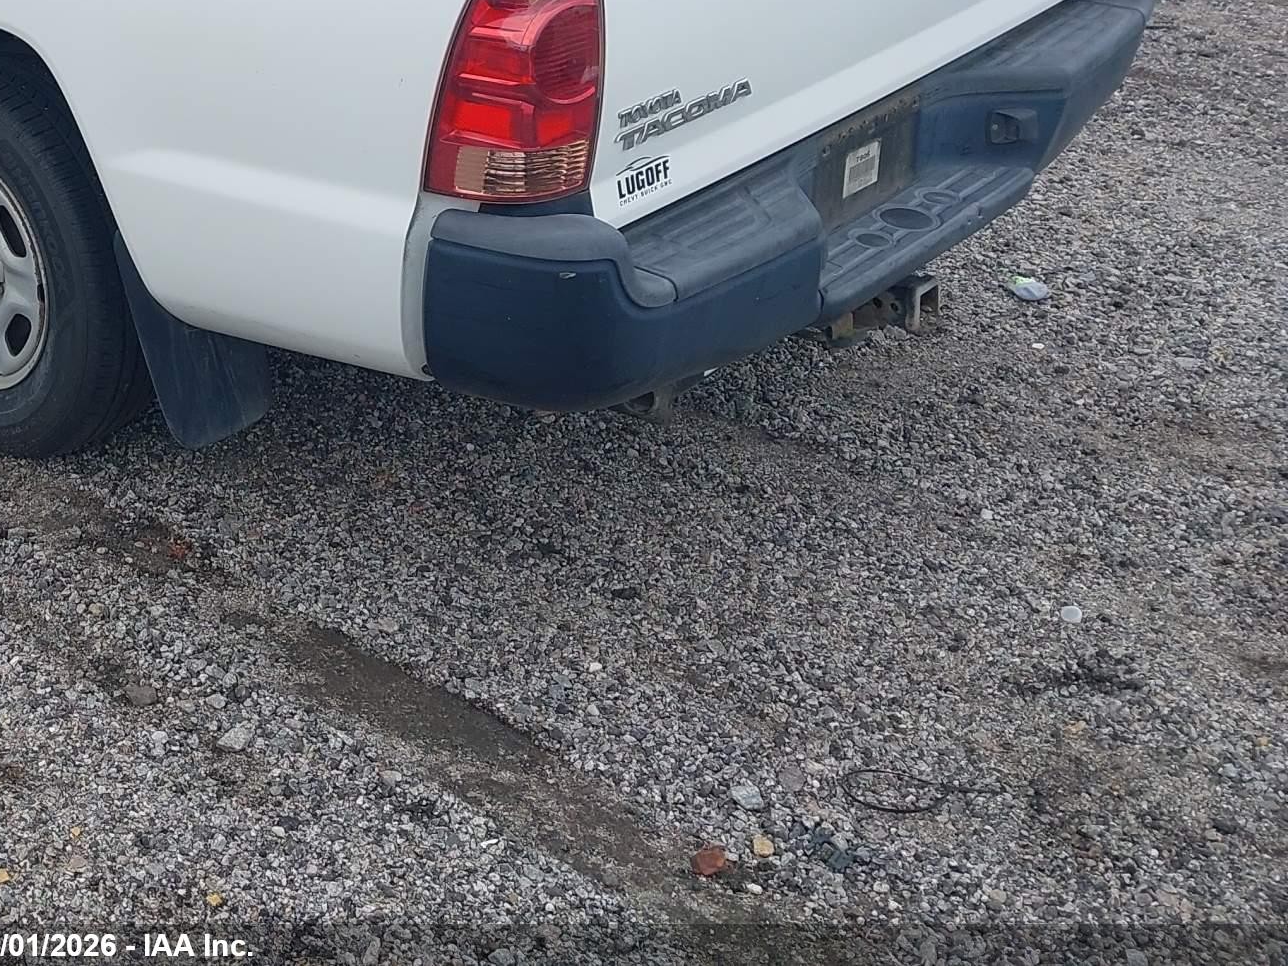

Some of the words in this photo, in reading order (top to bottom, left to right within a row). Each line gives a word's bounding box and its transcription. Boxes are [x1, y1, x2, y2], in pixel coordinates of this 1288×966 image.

[614, 78, 752, 151] TACOMA
[617, 89, 682, 129] TOYOTA
[617, 159, 670, 199] LUGOFF
